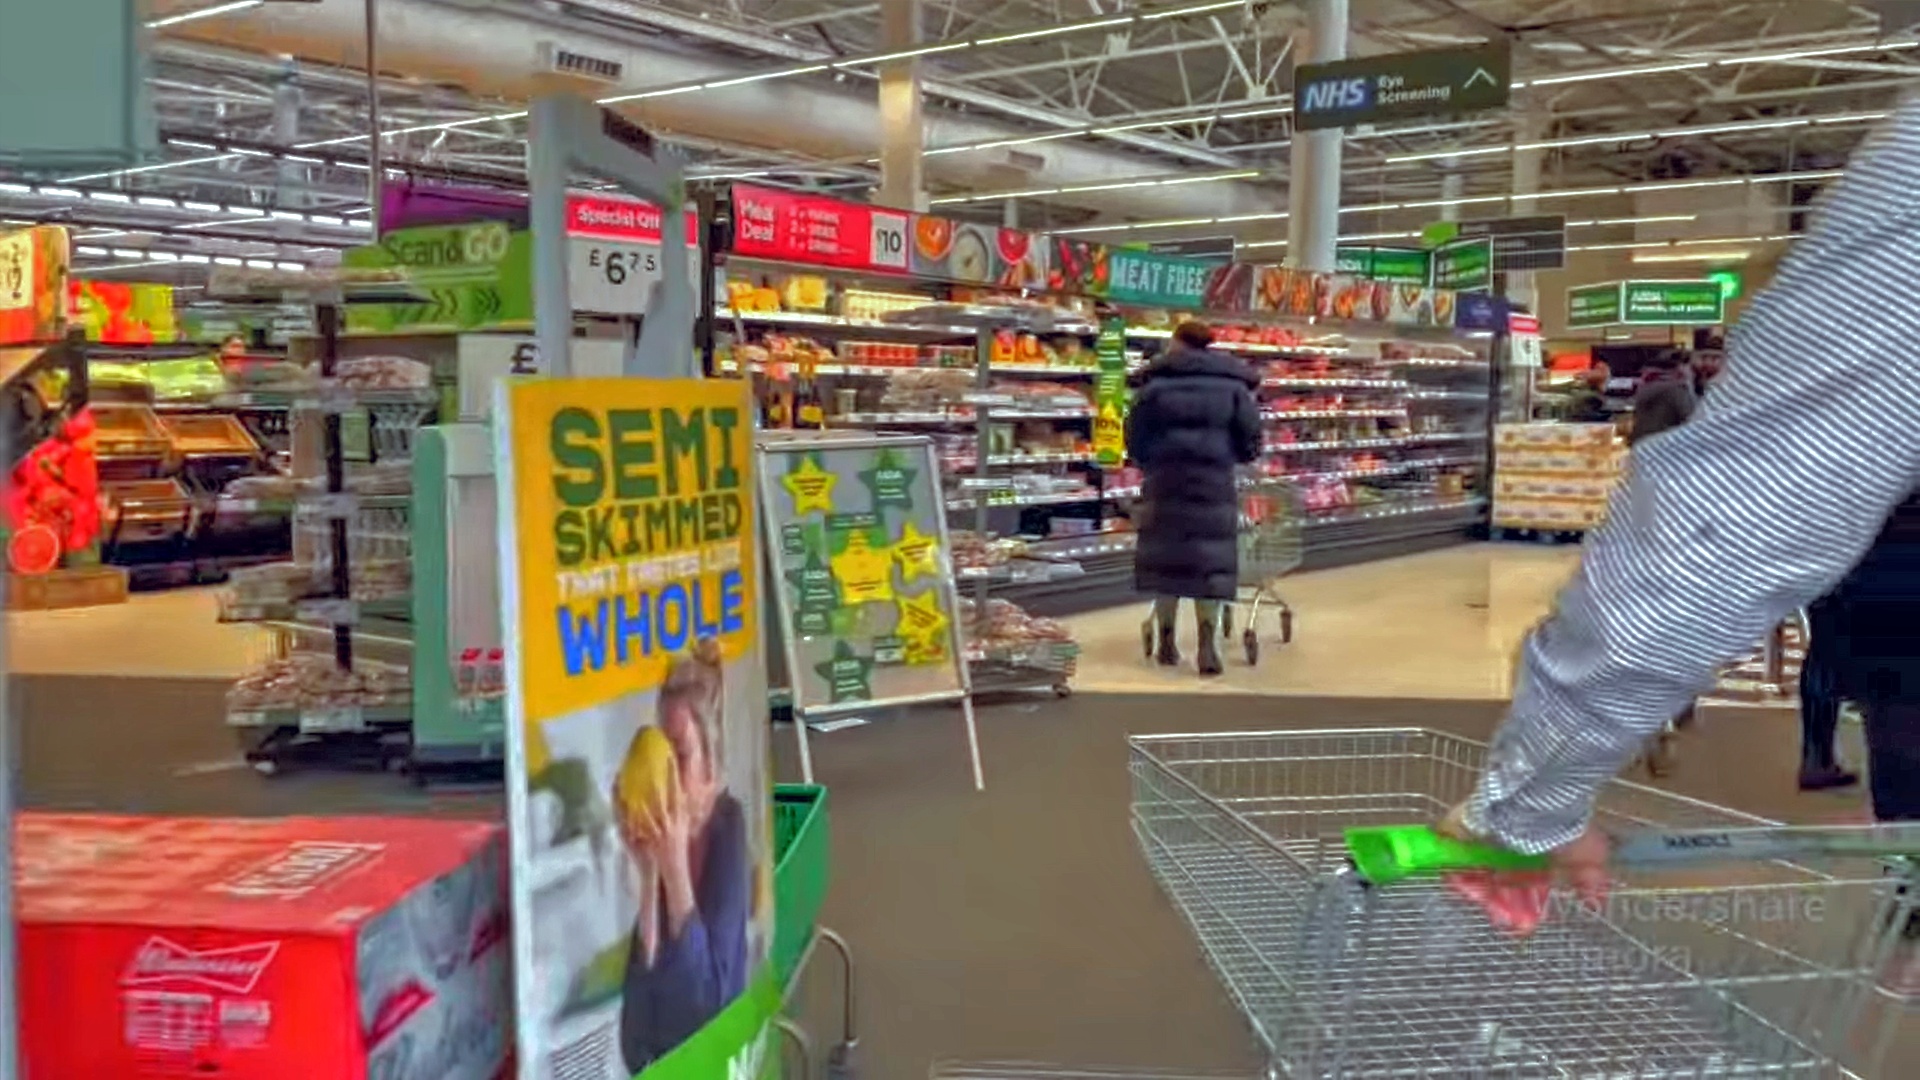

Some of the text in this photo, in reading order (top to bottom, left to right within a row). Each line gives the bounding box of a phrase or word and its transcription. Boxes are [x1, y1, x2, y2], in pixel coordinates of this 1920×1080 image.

[1303, 78, 1366, 112] NHS
[1377, 74, 1404, 89] Eye
[1378, 85, 1451, 105] Screening
[577, 203, 635, 230] Special
[1110, 254, 1205, 296] MEAT FREE
[552, 406, 739, 508] SEMI
[554, 493, 743, 567] SKIMMED
[557, 568, 746, 677] WHOLE
